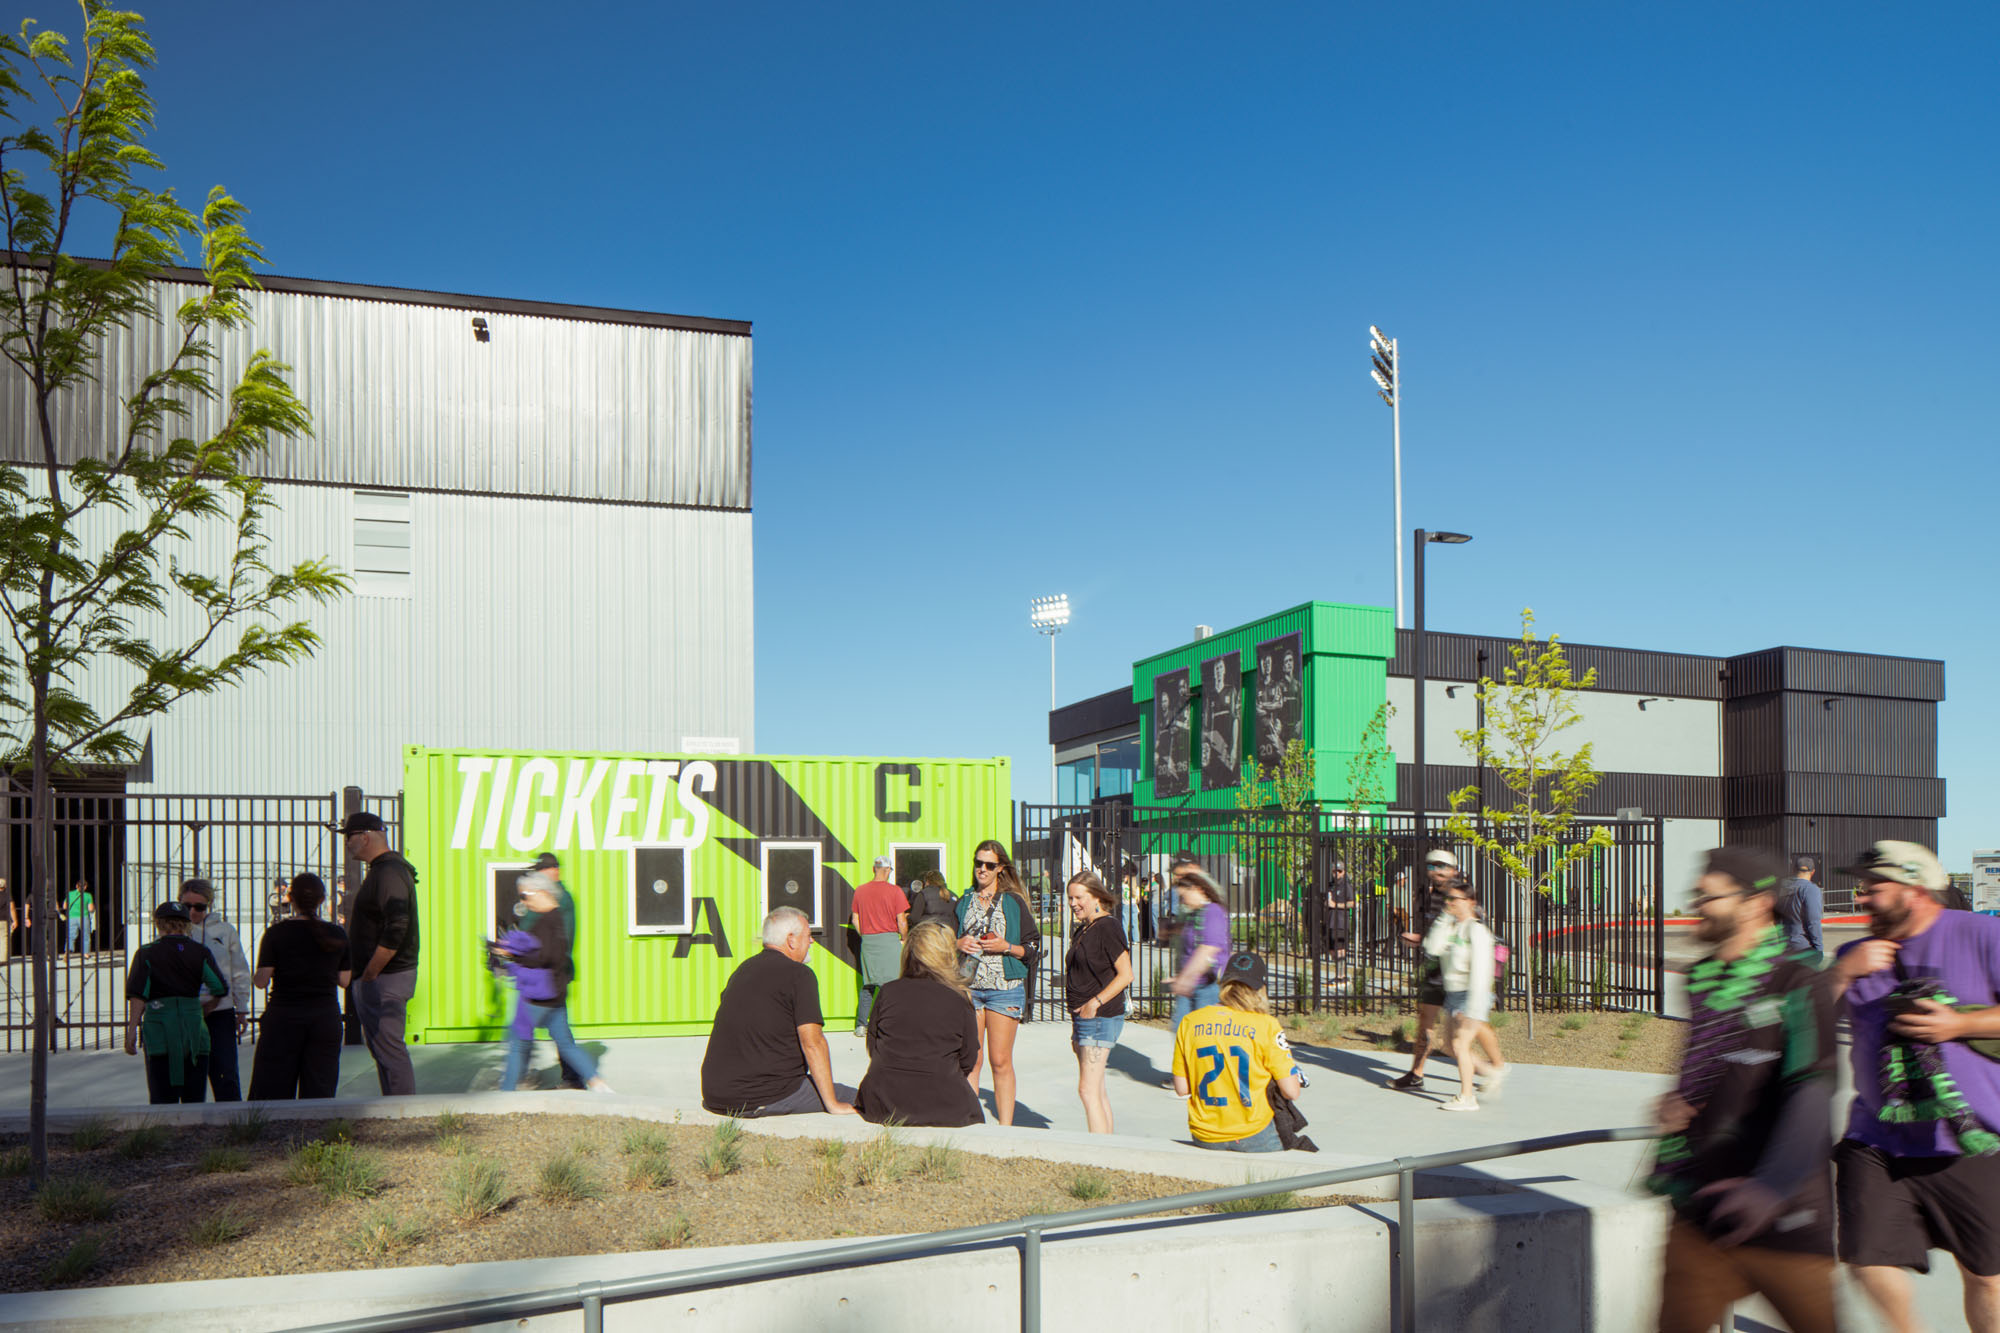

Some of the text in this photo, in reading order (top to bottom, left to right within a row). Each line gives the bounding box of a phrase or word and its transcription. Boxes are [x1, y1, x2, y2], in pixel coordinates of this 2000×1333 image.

[451, 757, 717, 852] TICKETS
[874, 763, 922, 823] C
[672, 897, 733, 958] A
[1194, 1018, 1256, 1040] manduca
[1196, 1045, 1252, 1107] 21
